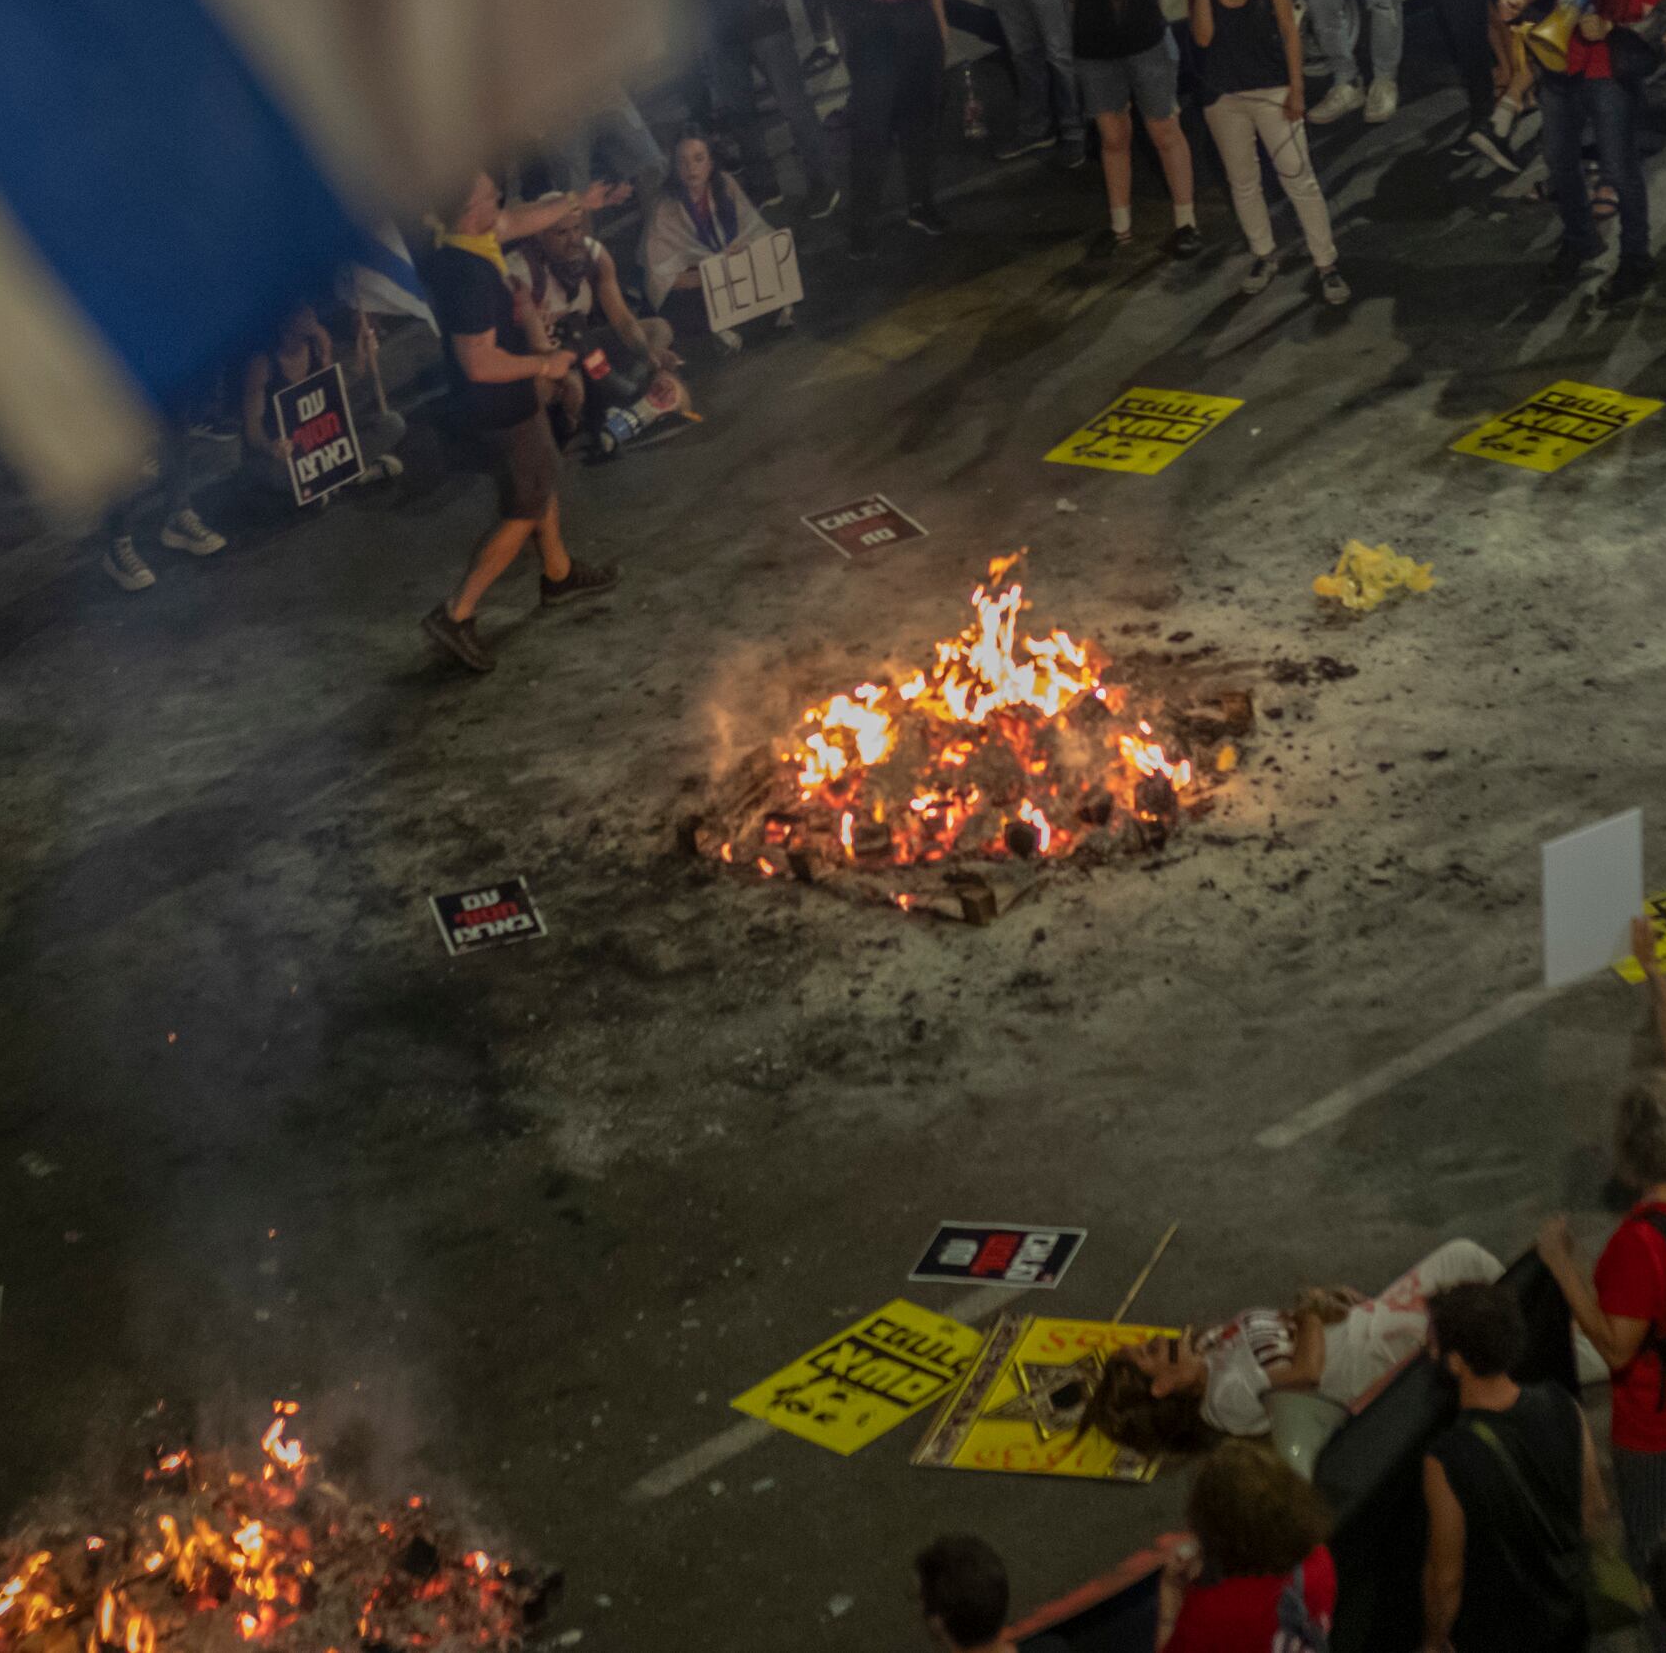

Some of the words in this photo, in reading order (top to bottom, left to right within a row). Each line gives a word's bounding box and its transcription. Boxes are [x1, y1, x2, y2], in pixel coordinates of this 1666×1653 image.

[704, 232, 793, 320] HELP
[296, 388, 327, 424] עם
[296, 435, 355, 485] בארצו
[461, 888, 501, 912] עם
[452, 912, 535, 945] בארצו
[808, 1336, 951, 1407] אשם
